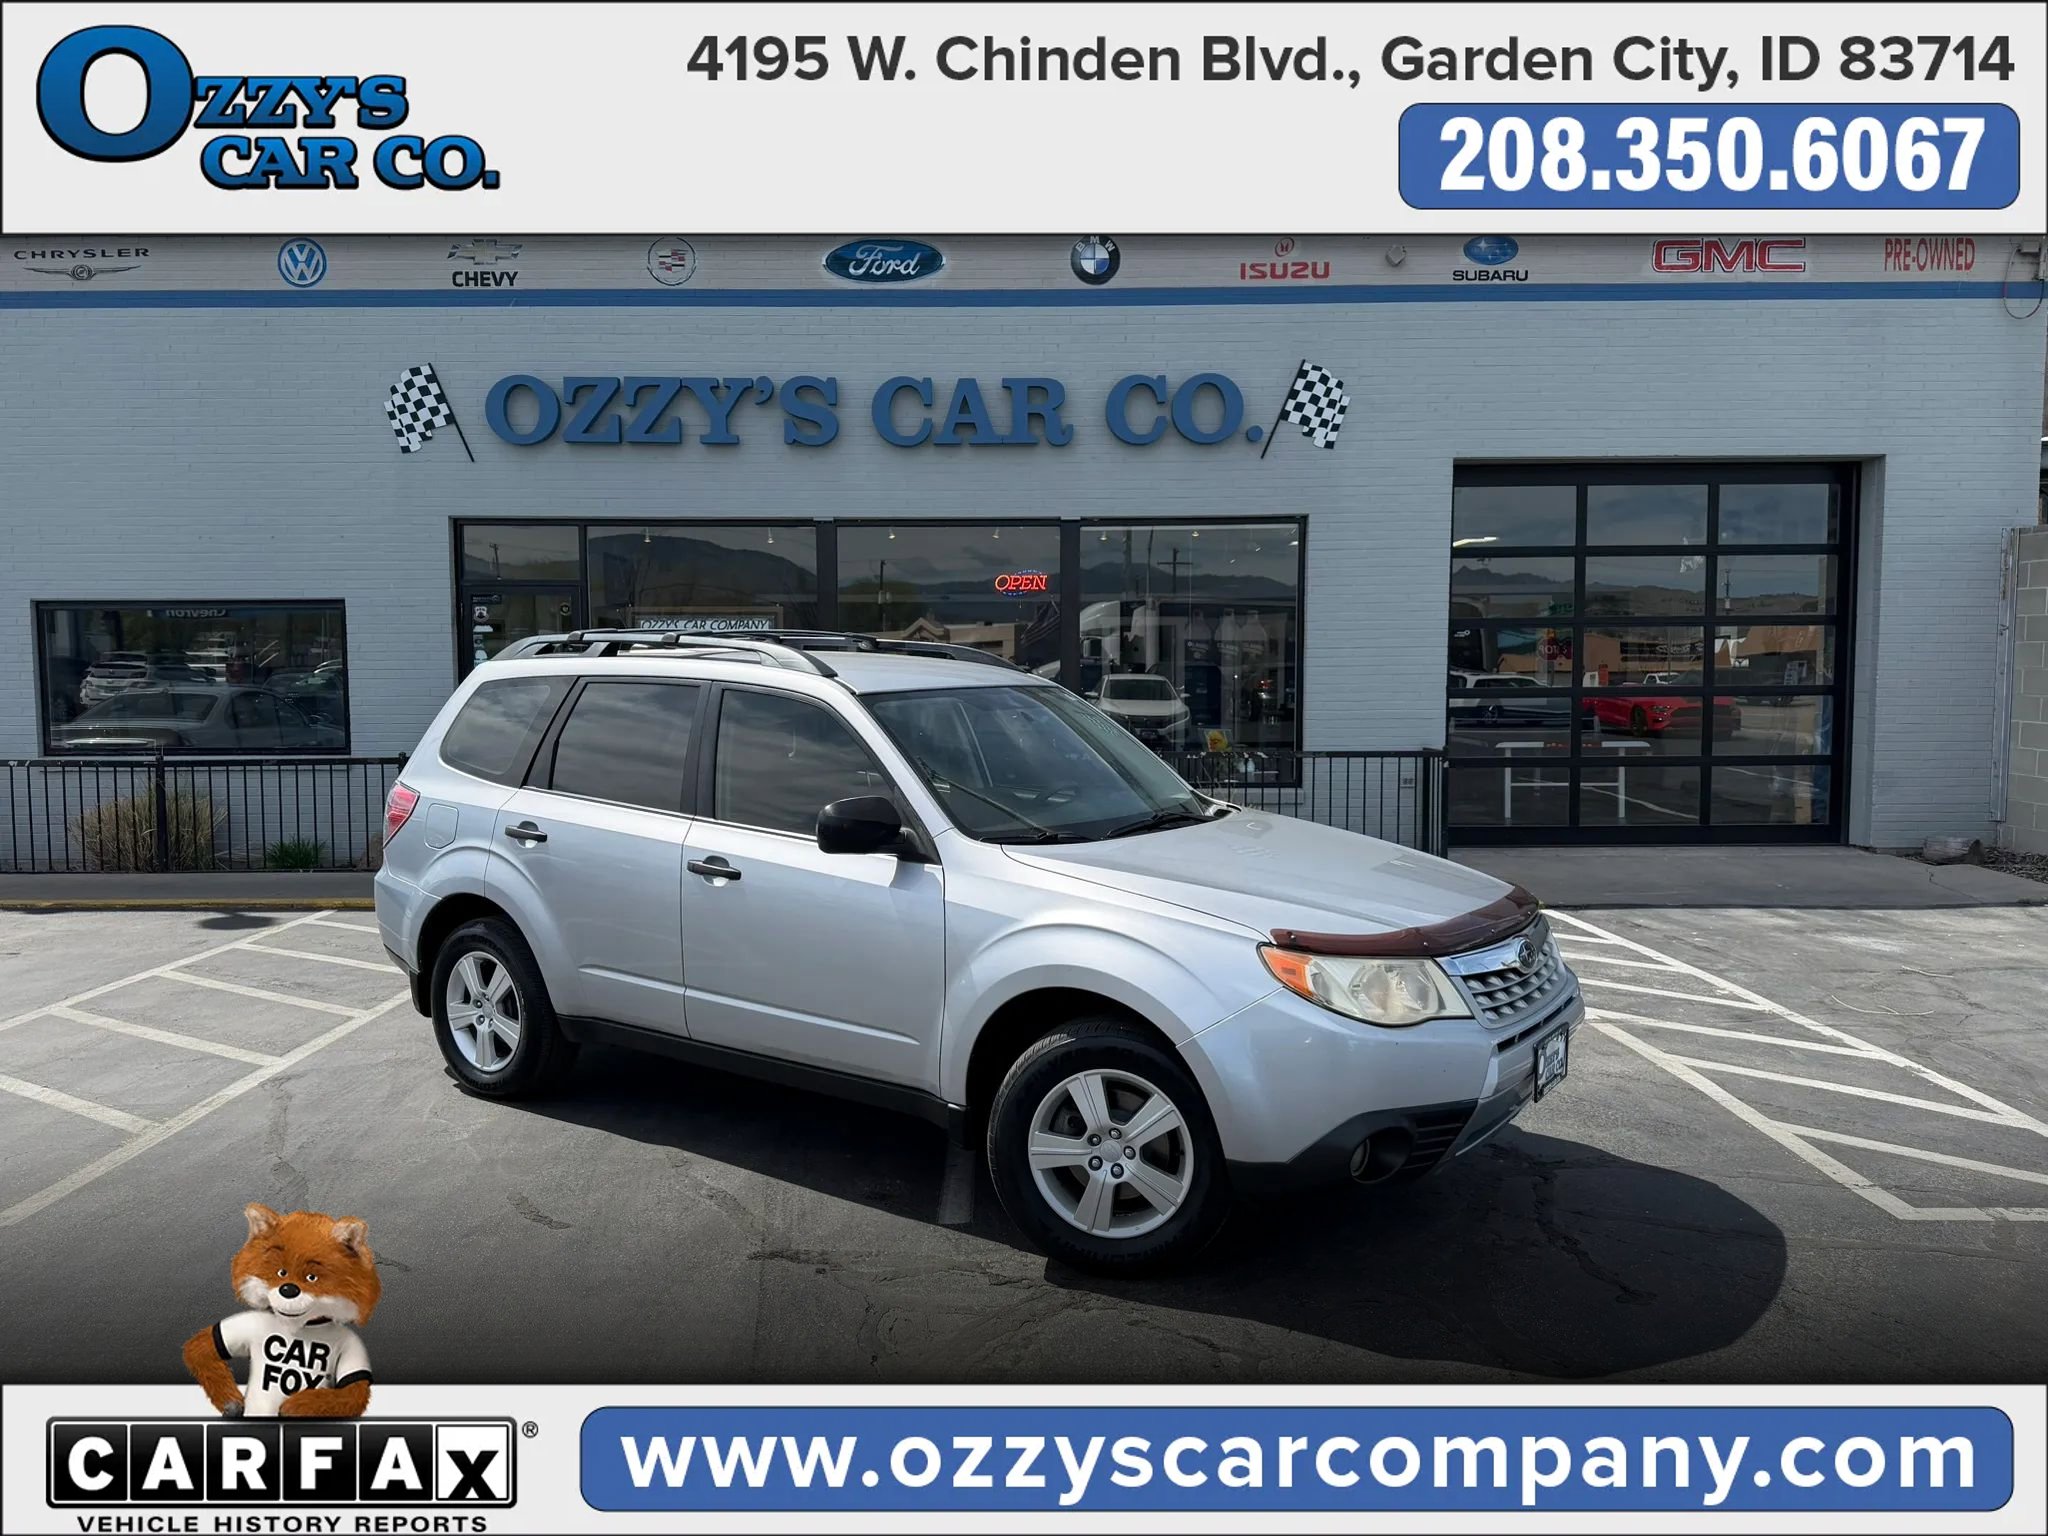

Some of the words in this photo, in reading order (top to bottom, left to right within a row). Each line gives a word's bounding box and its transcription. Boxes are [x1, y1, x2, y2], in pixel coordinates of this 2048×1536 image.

[1075, 235, 1115, 252] BMW
[13, 247, 150, 260] CHRYSLER
[848, 244, 920, 275] Ford
[1653, 238, 1805, 273] GMC
[1884, 238, 1975, 272] PRE-OWNED
[452, 270, 518, 287] CHEVY
[1240, 261, 1330, 280] ISUZU
[1452, 269, 1529, 281] SUBARU
[485, 374, 839, 446] OZZY'S
[871, 376, 1074, 447] CAR
[1105, 373, 1264, 445] CO.
[995, 574, 1047, 590] OPEN
[684, 619, 706, 630] CAR
[710, 619, 769, 630] COMPANY
